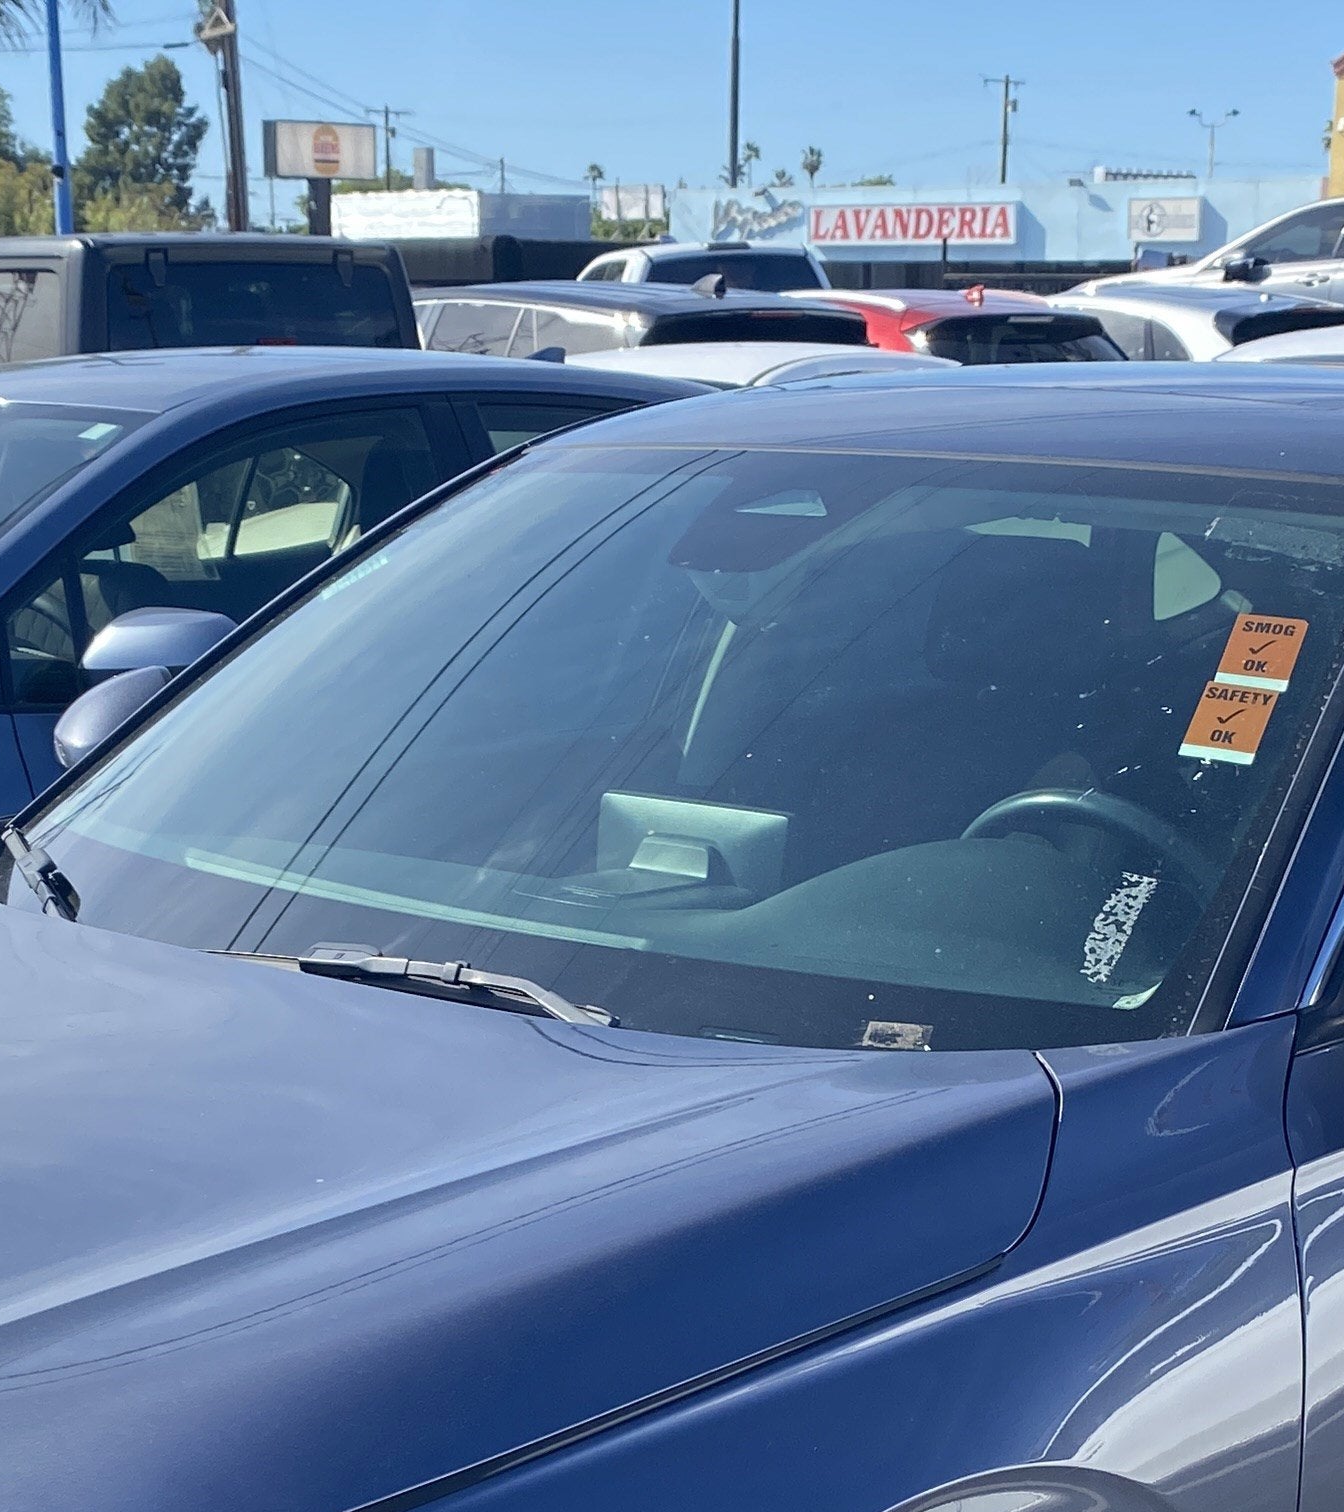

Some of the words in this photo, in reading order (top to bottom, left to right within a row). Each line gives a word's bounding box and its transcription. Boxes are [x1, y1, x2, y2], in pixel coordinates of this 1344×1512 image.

[812, 206, 1012, 240] LAVANDERIA
[1243, 620, 1296, 636] SMOG
[1243, 659, 1268, 673] OK
[1207, 687, 1273, 705] SAFETY
[1210, 729, 1237, 744] OK
